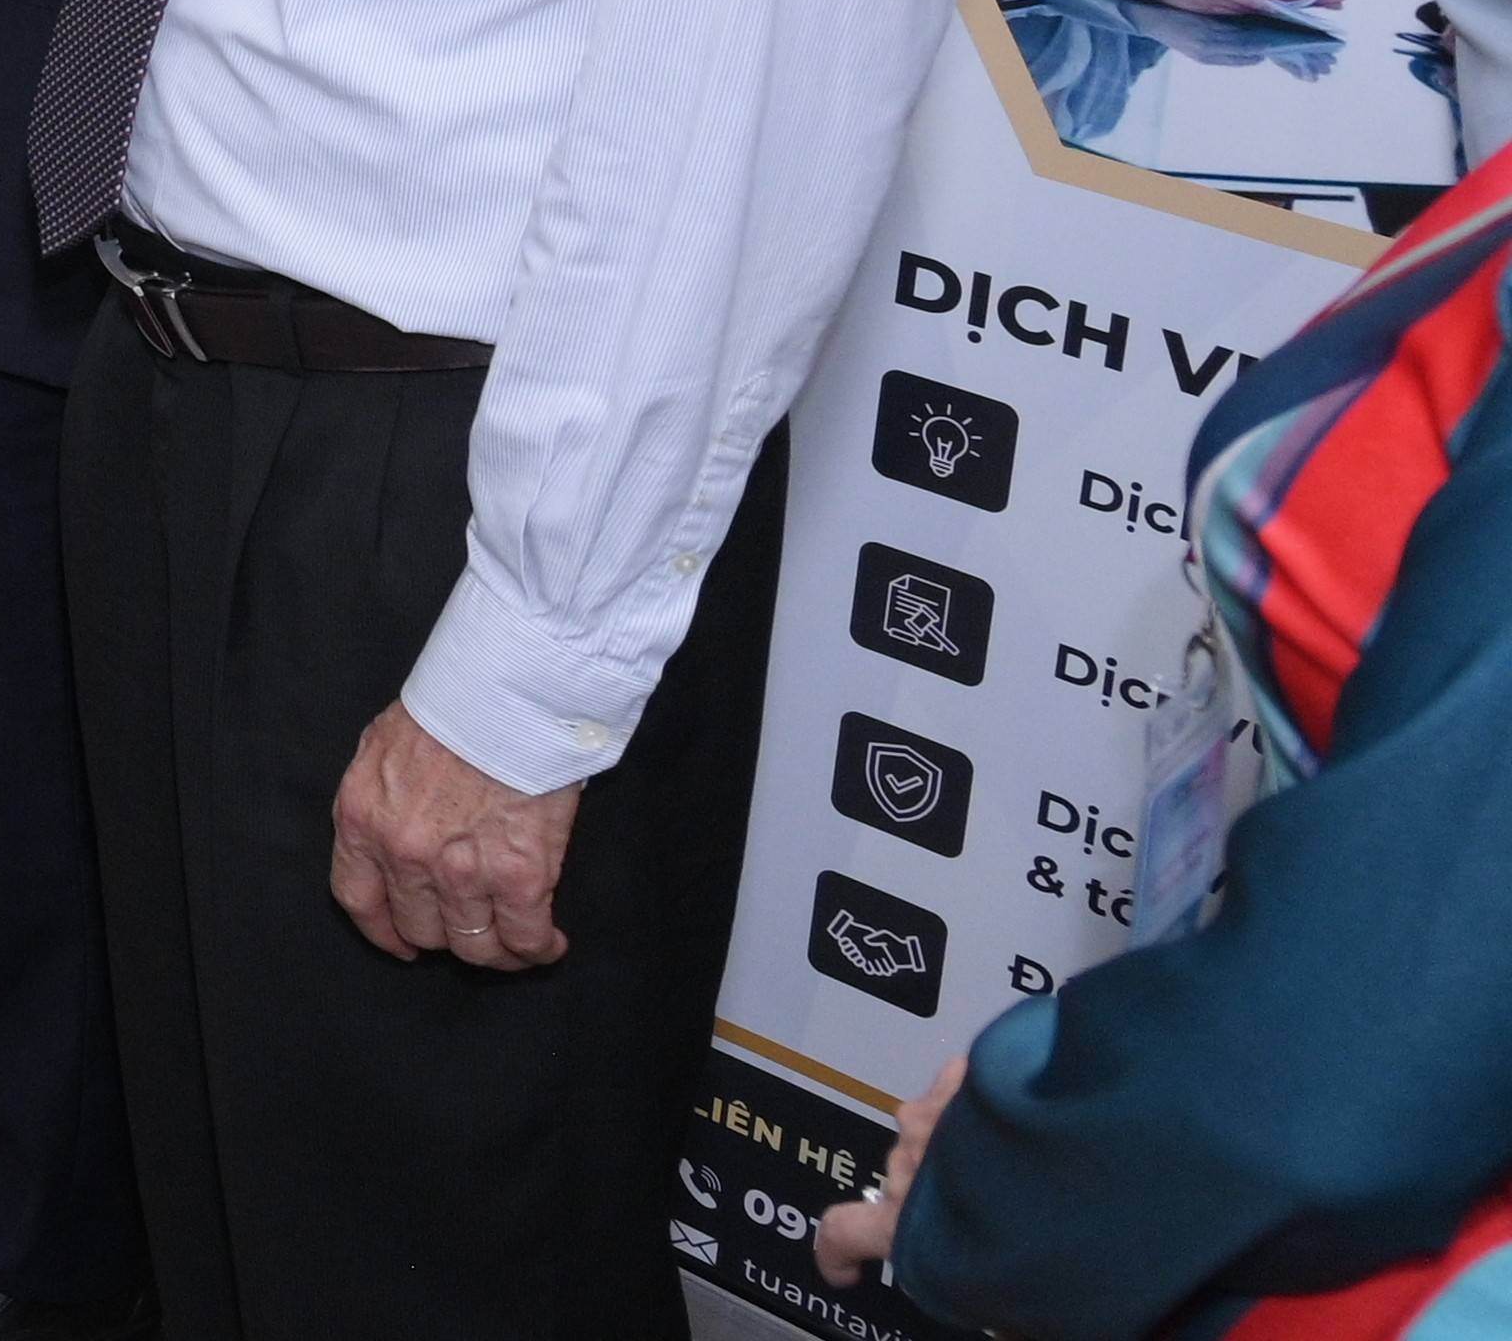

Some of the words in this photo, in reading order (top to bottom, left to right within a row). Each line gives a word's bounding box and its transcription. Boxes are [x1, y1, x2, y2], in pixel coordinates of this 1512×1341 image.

[895, 250, 1130, 372] DỊCH
[1162, 327, 1262, 397] V
[1079, 469, 1189, 542] Dịc
[1054, 643, 1171, 710] Dịc
[1037, 790, 1135, 859] Dịc
[1026, 855, 1065, 898] &
[694, 1096, 784, 1152] IÊN
[797, 1137, 857, 1191] HỆ
[743, 1188, 820, 1251] 09
